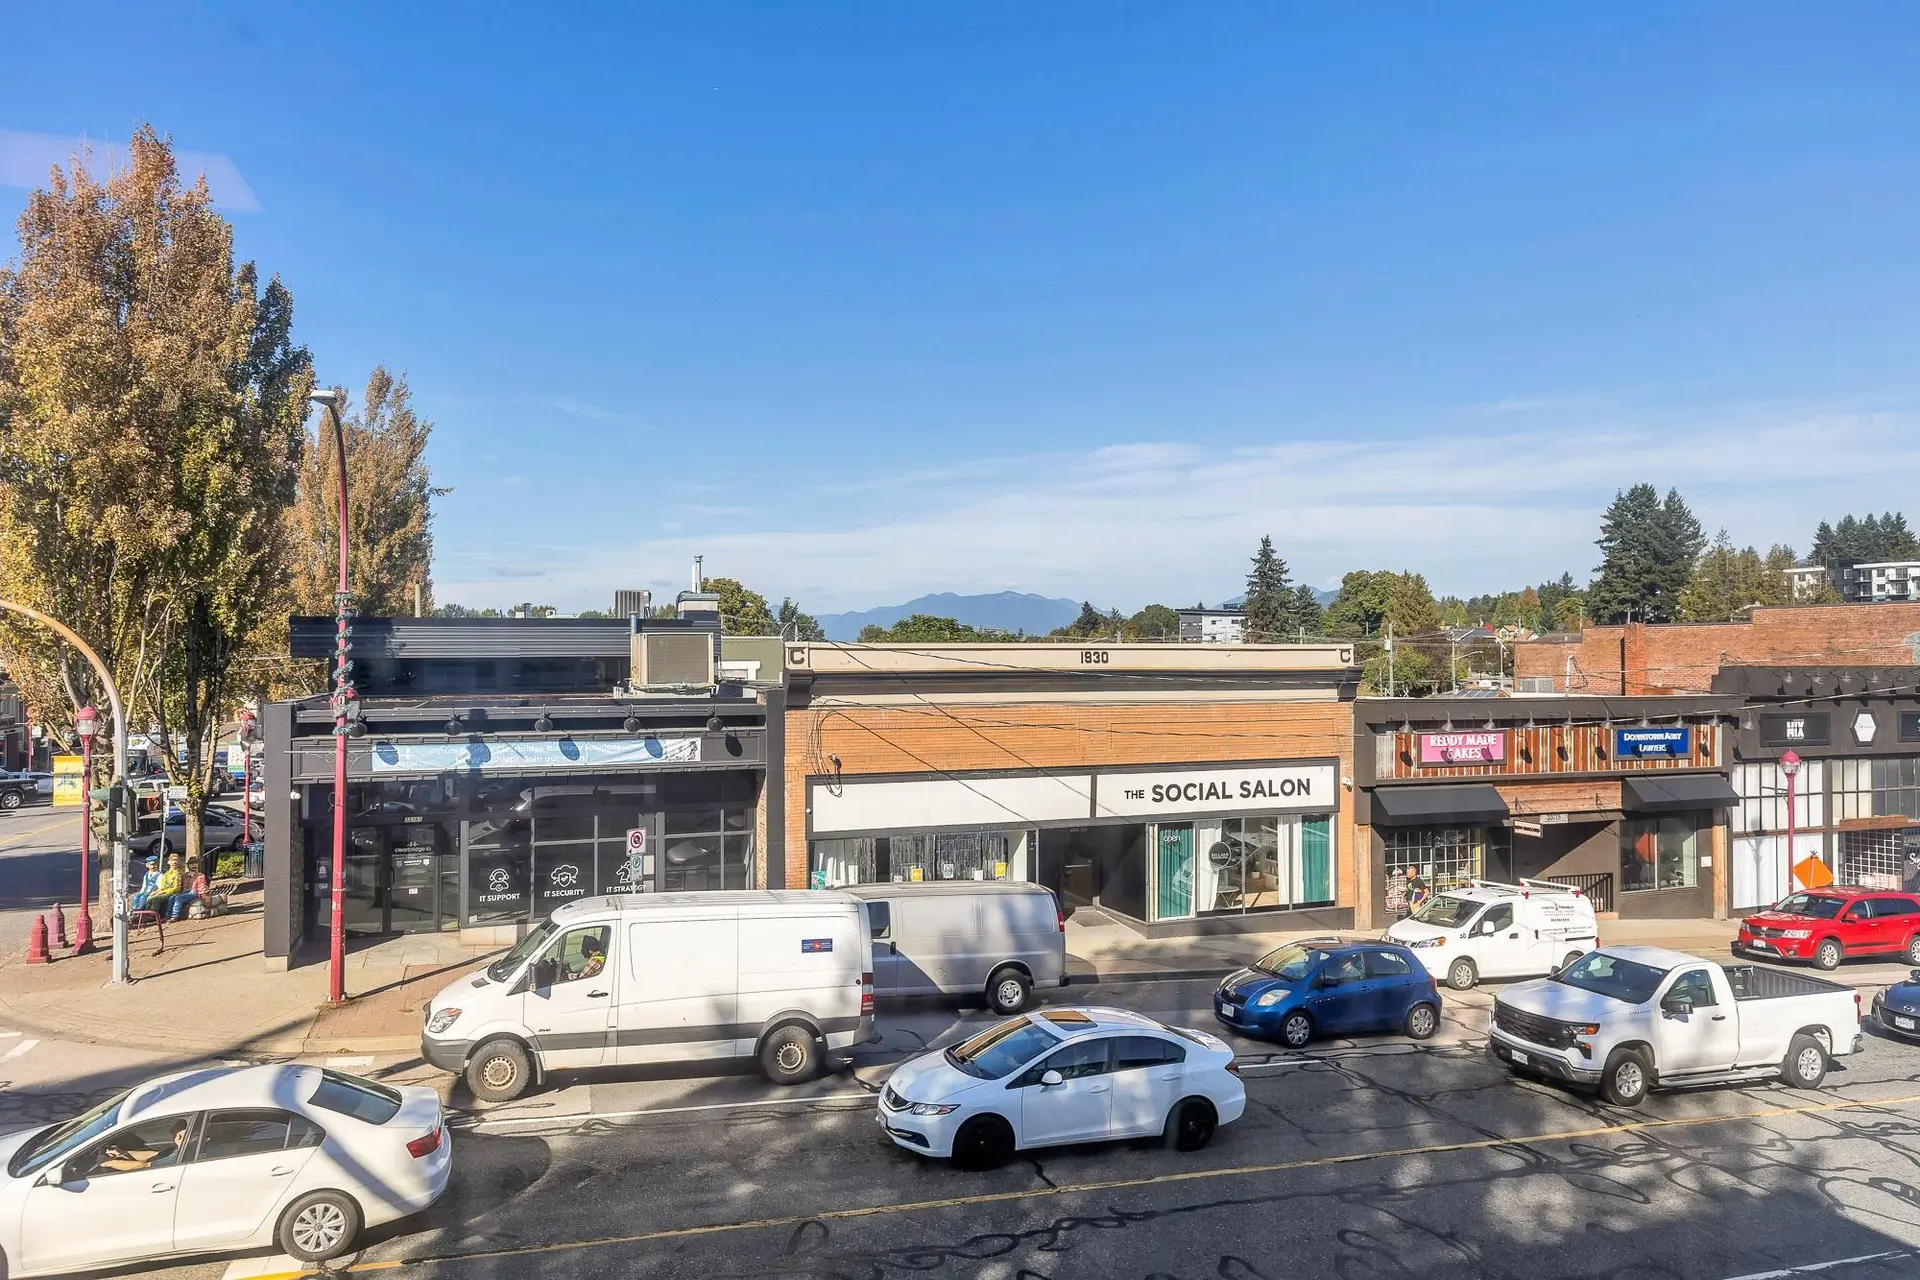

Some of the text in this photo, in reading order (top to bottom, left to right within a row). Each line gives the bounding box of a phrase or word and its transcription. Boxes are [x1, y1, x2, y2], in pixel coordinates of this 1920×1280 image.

[1080, 651, 1109, 664] 1930
[1430, 733, 1497, 746] REDDY MADE
[1447, 747, 1481, 759] CAKES
[1124, 778, 1311, 802] THE SOCIAL SALON
[544, 888, 586, 898] IT SECURITY
[606, 884, 647, 893] IT STRATGY
[487, 893, 521, 902] SUPPORT
